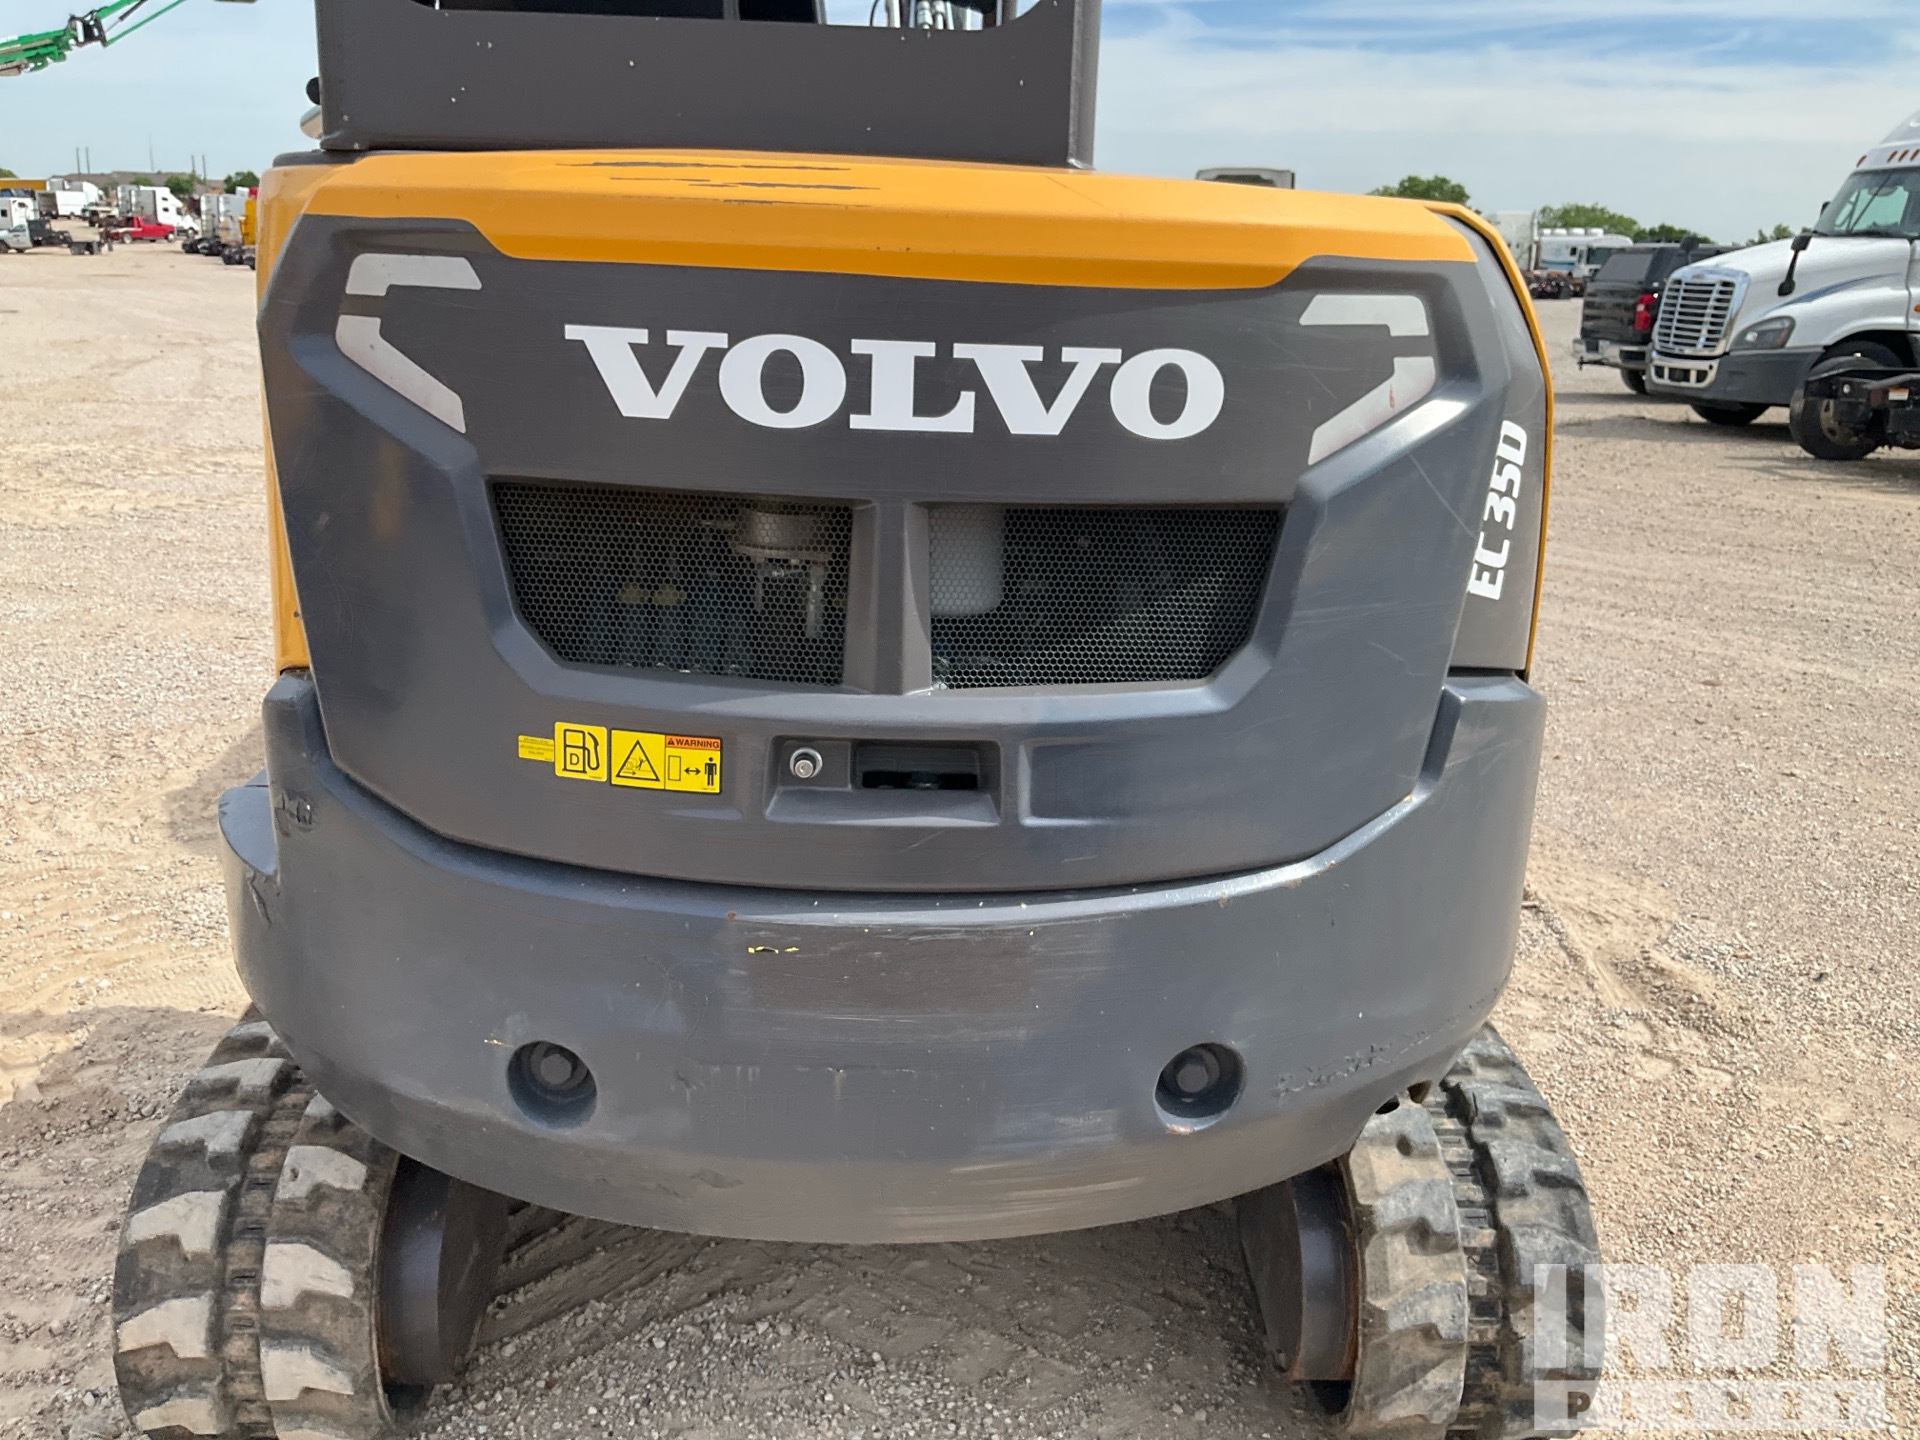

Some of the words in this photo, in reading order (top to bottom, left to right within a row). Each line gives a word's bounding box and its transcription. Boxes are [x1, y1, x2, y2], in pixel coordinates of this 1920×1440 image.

[564, 324, 1225, 440] VOLVO
[675, 738, 720, 749] WARNING
[569, 753, 579, 766] D
